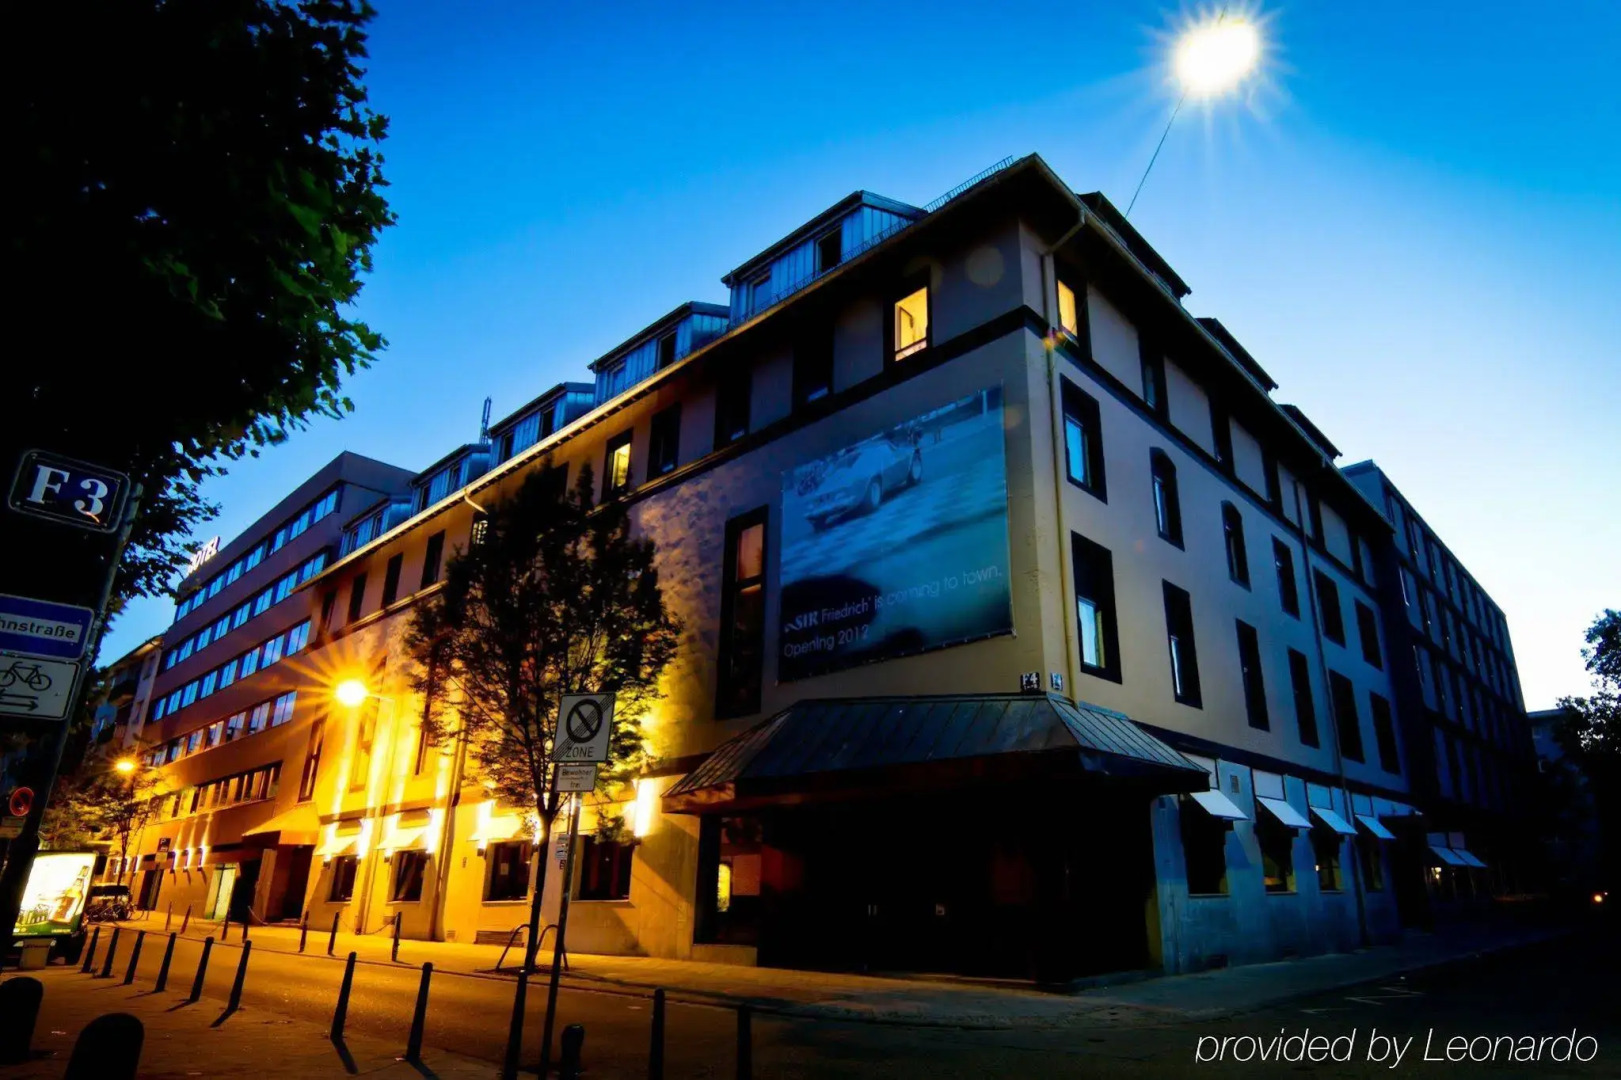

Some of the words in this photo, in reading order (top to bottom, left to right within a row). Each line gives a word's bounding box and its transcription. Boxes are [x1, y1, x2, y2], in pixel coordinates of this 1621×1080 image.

[784, 611, 819, 632] SIR
[875, 594, 884, 611] is
[886, 580, 940, 605] coming
[943, 576, 959, 590] to
[784, 636, 835, 657] Opening
[838, 624, 869, 645] 2012
[565, 746, 594, 758] ZONE
